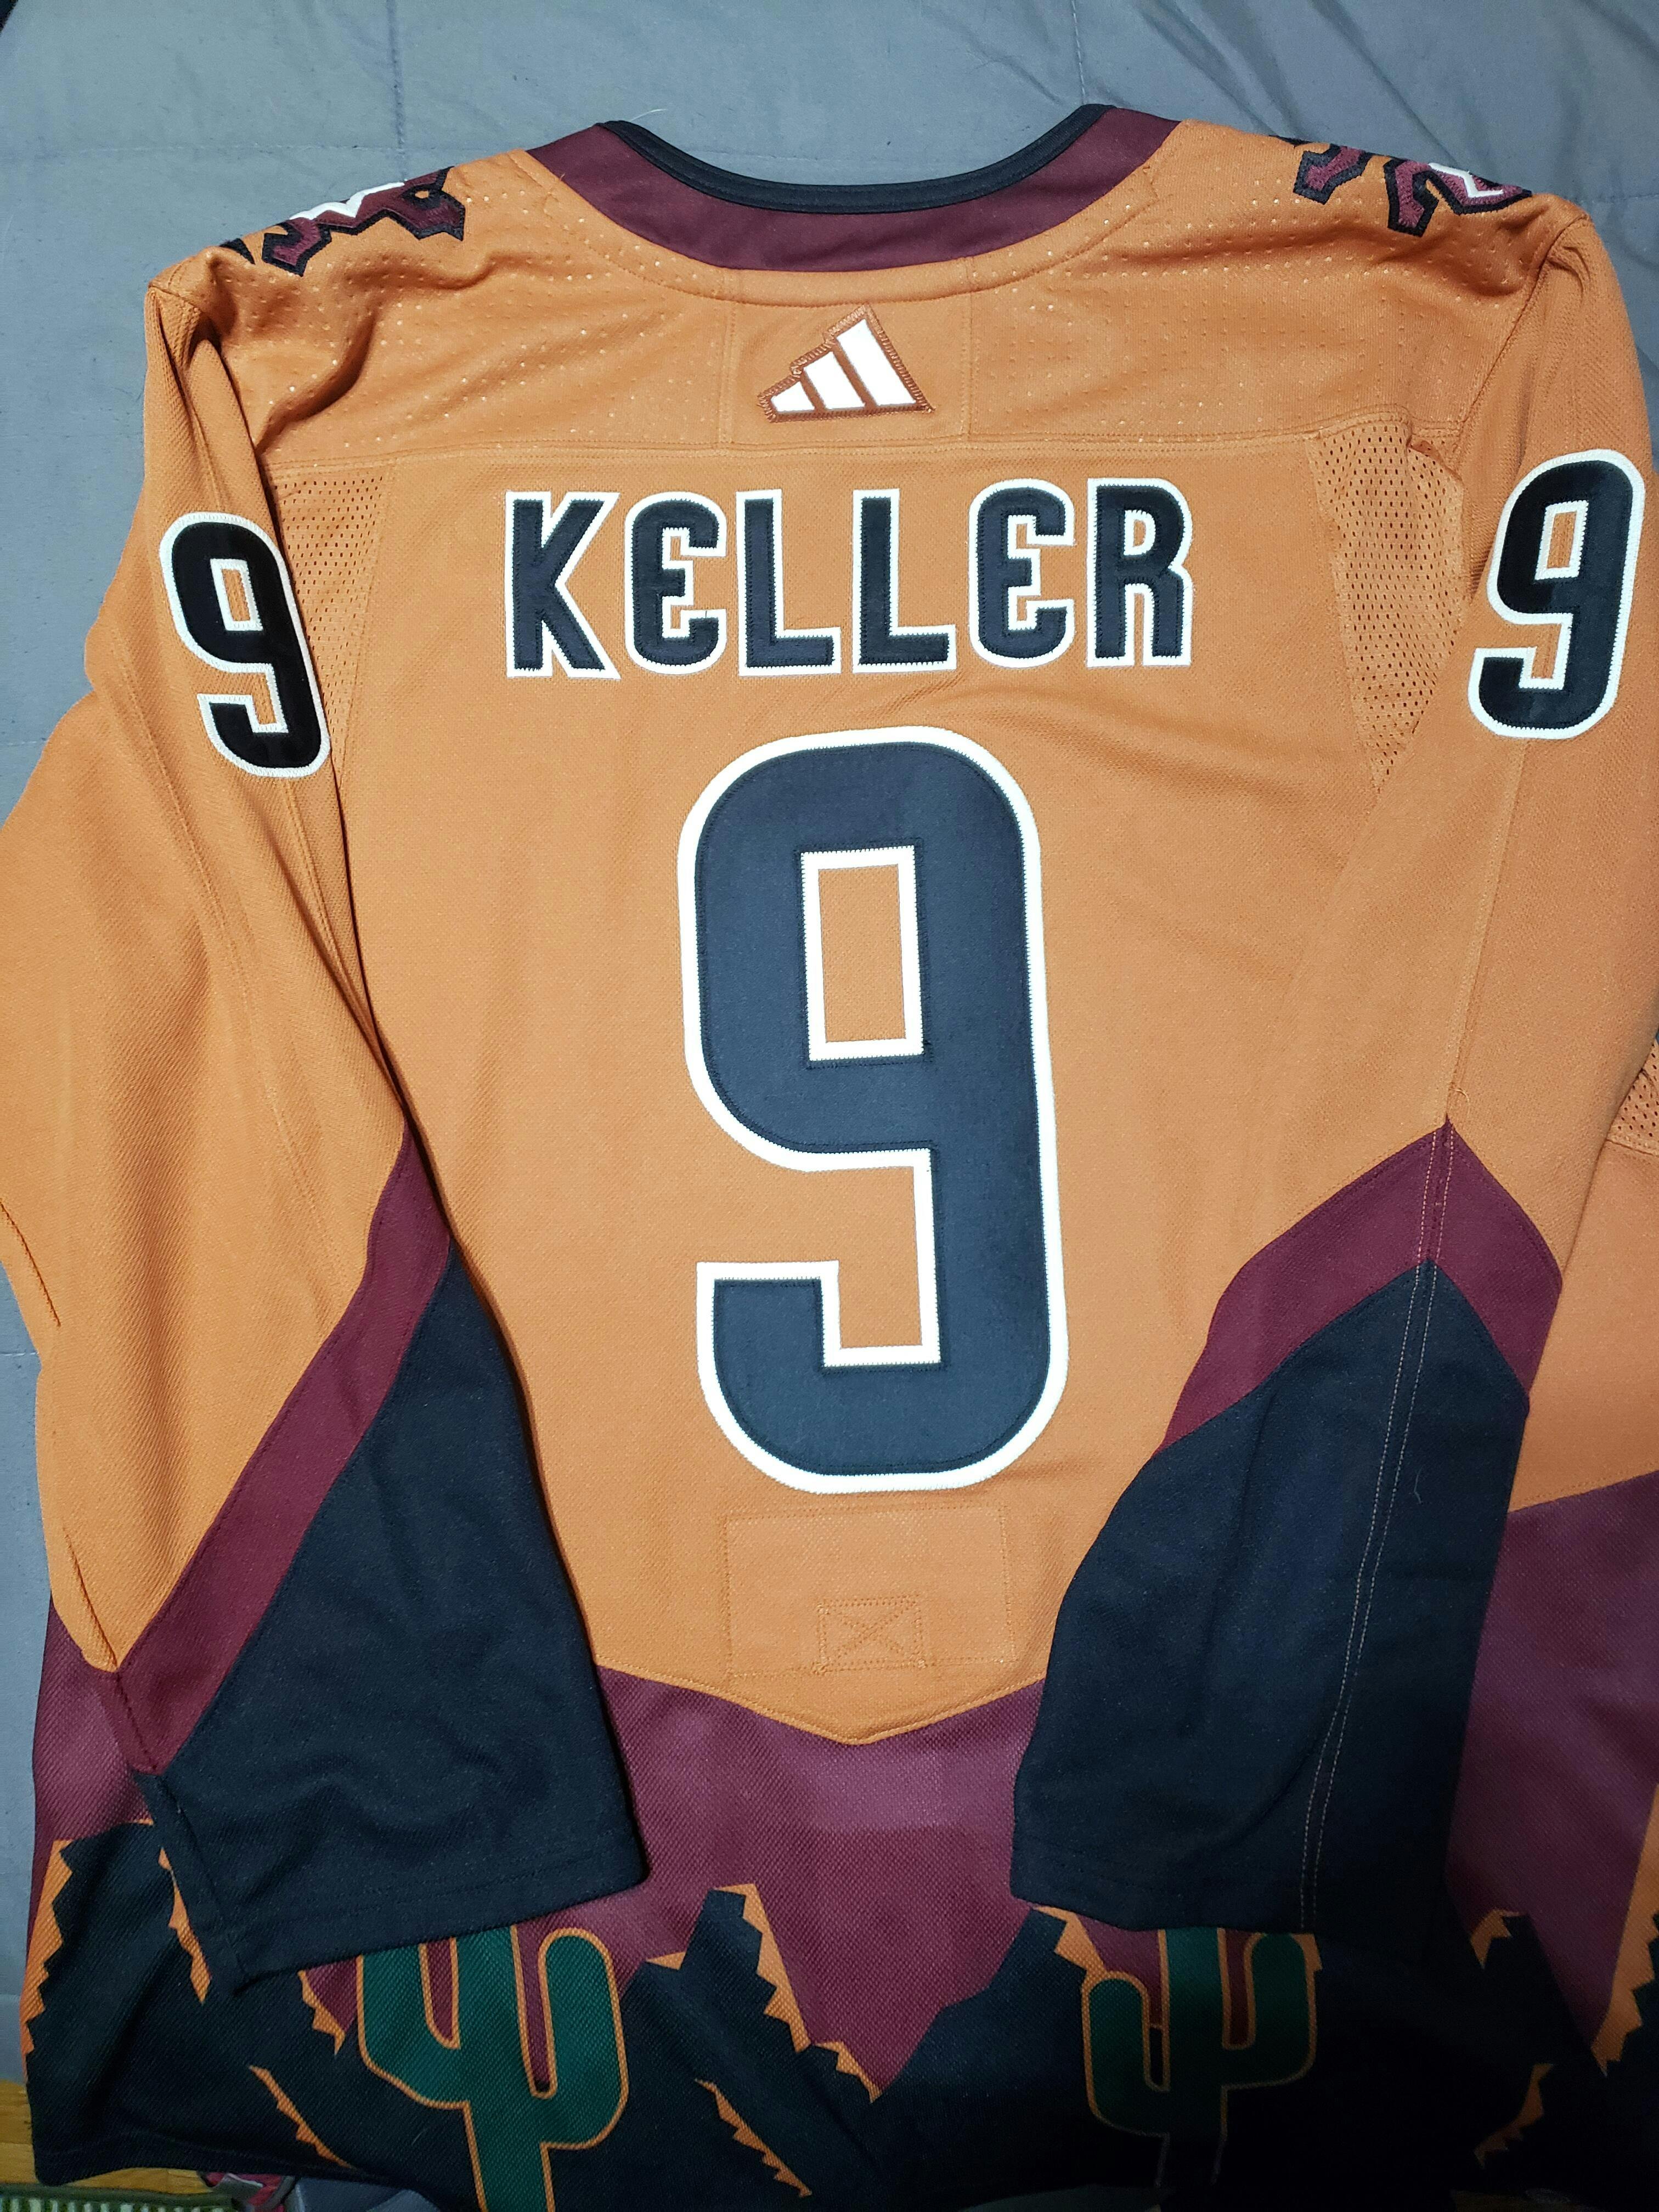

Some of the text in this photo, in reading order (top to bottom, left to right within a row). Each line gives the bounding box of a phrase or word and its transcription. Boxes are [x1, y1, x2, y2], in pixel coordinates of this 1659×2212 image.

[159, 512, 330, 778] 9
[505, 478, 1194, 679] KELLER
[1468, 449, 1646, 740] 9
[678, 725, 1069, 1496] 9
